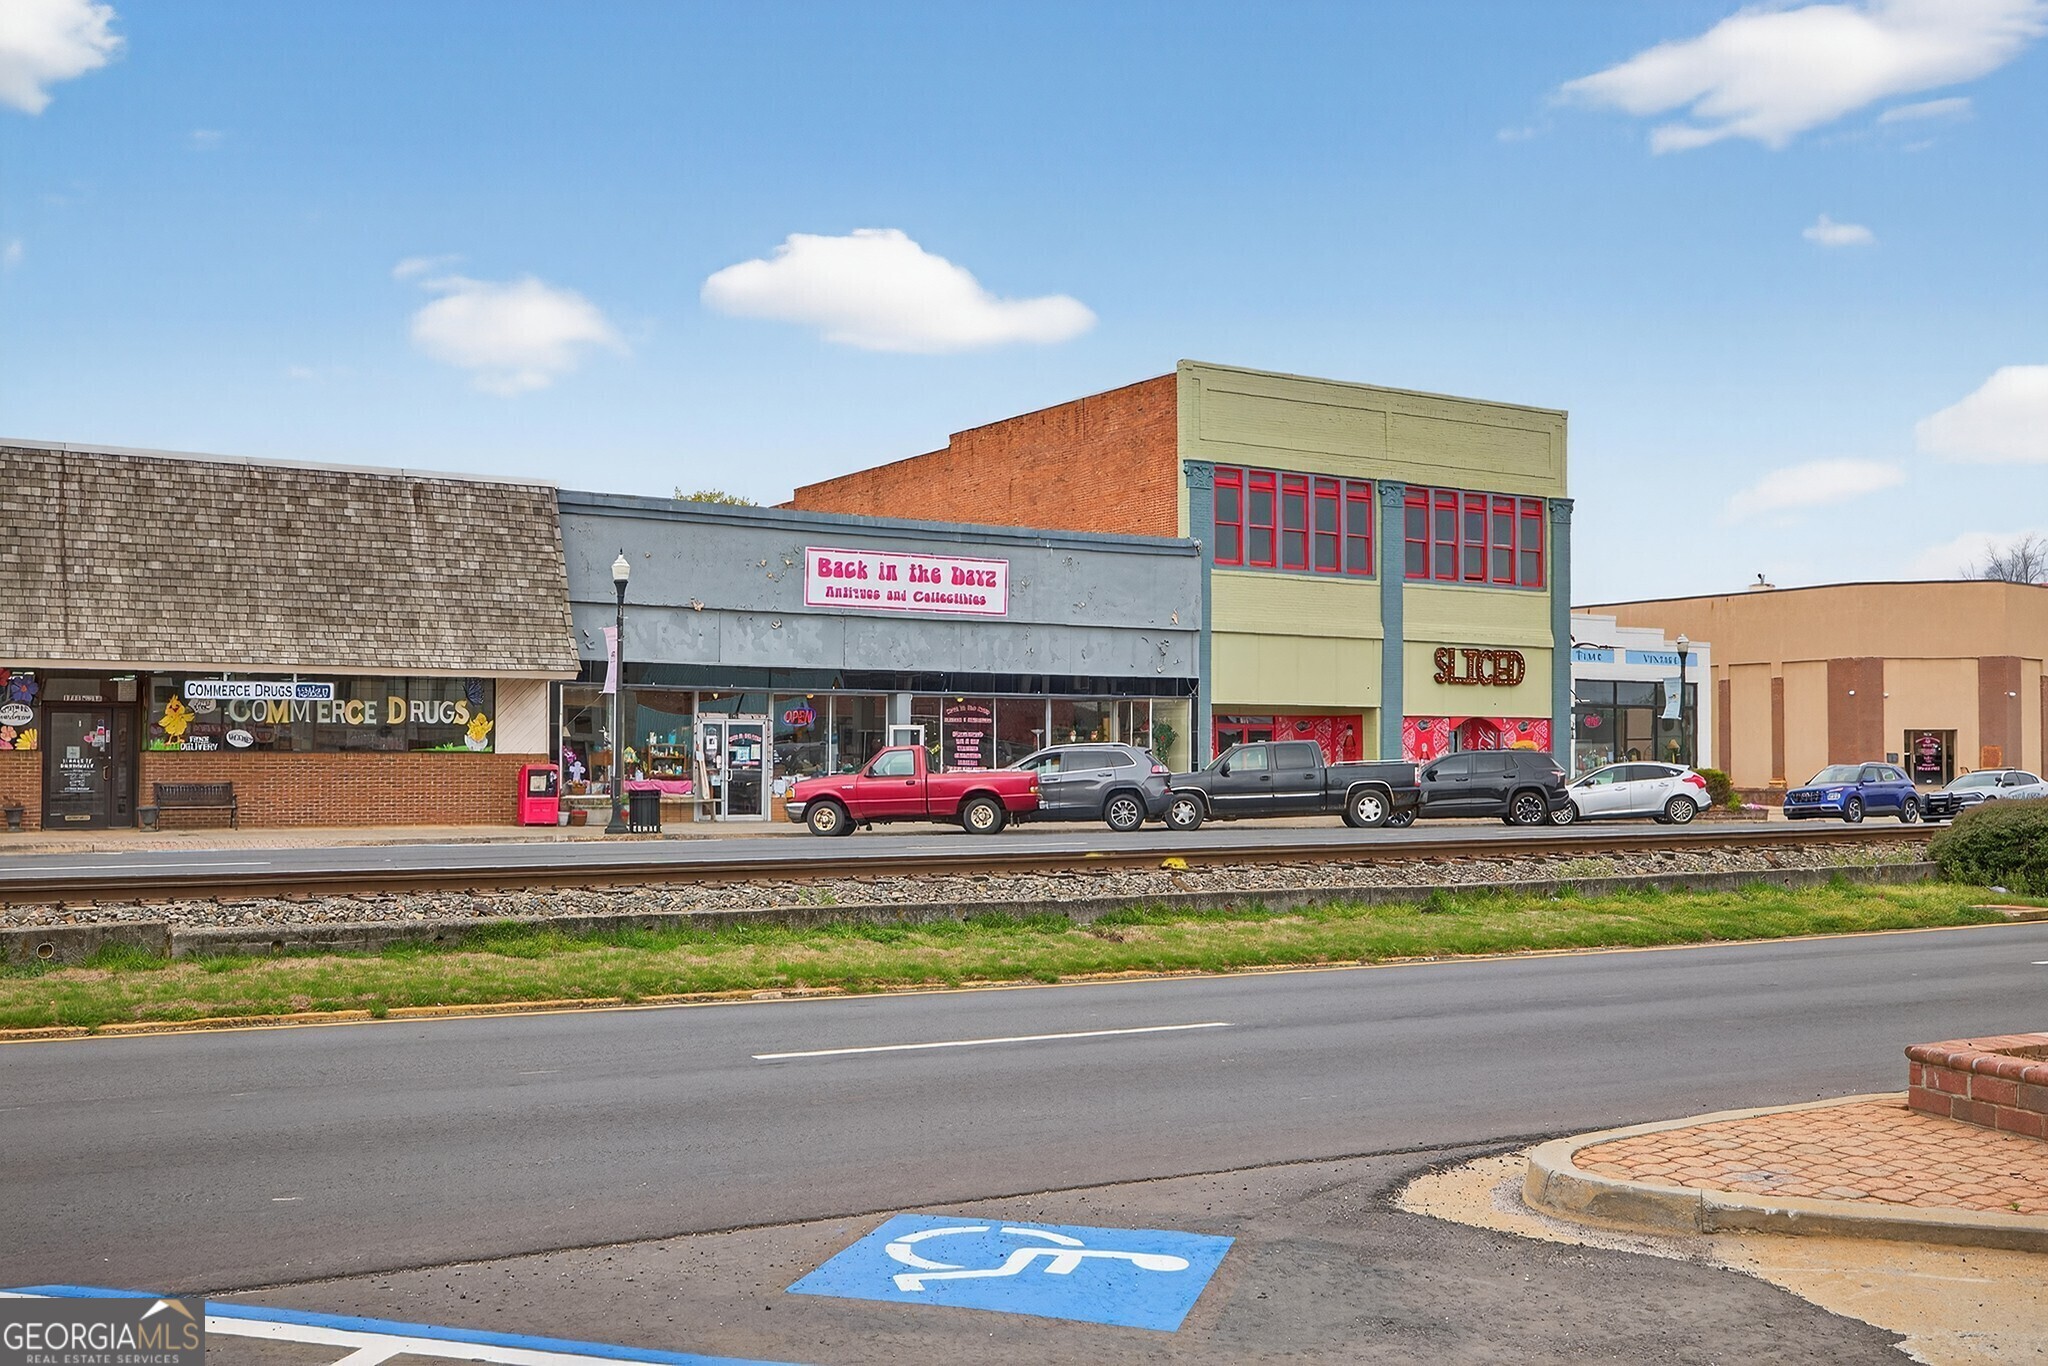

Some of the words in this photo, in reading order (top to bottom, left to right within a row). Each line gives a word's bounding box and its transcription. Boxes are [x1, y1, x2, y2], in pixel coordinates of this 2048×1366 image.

[817, 556, 868, 580] Back
[878, 561, 898, 582] in
[908, 563, 942, 584] the
[824, 585, 881, 600] Antiques
[886, 590, 907, 602] and
[912, 590, 987, 606] Collectibles
[1433, 646, 1526, 687] SLICED
[783, 709, 813, 724] OPEN
[180, 742, 219, 751] DELIVERY
